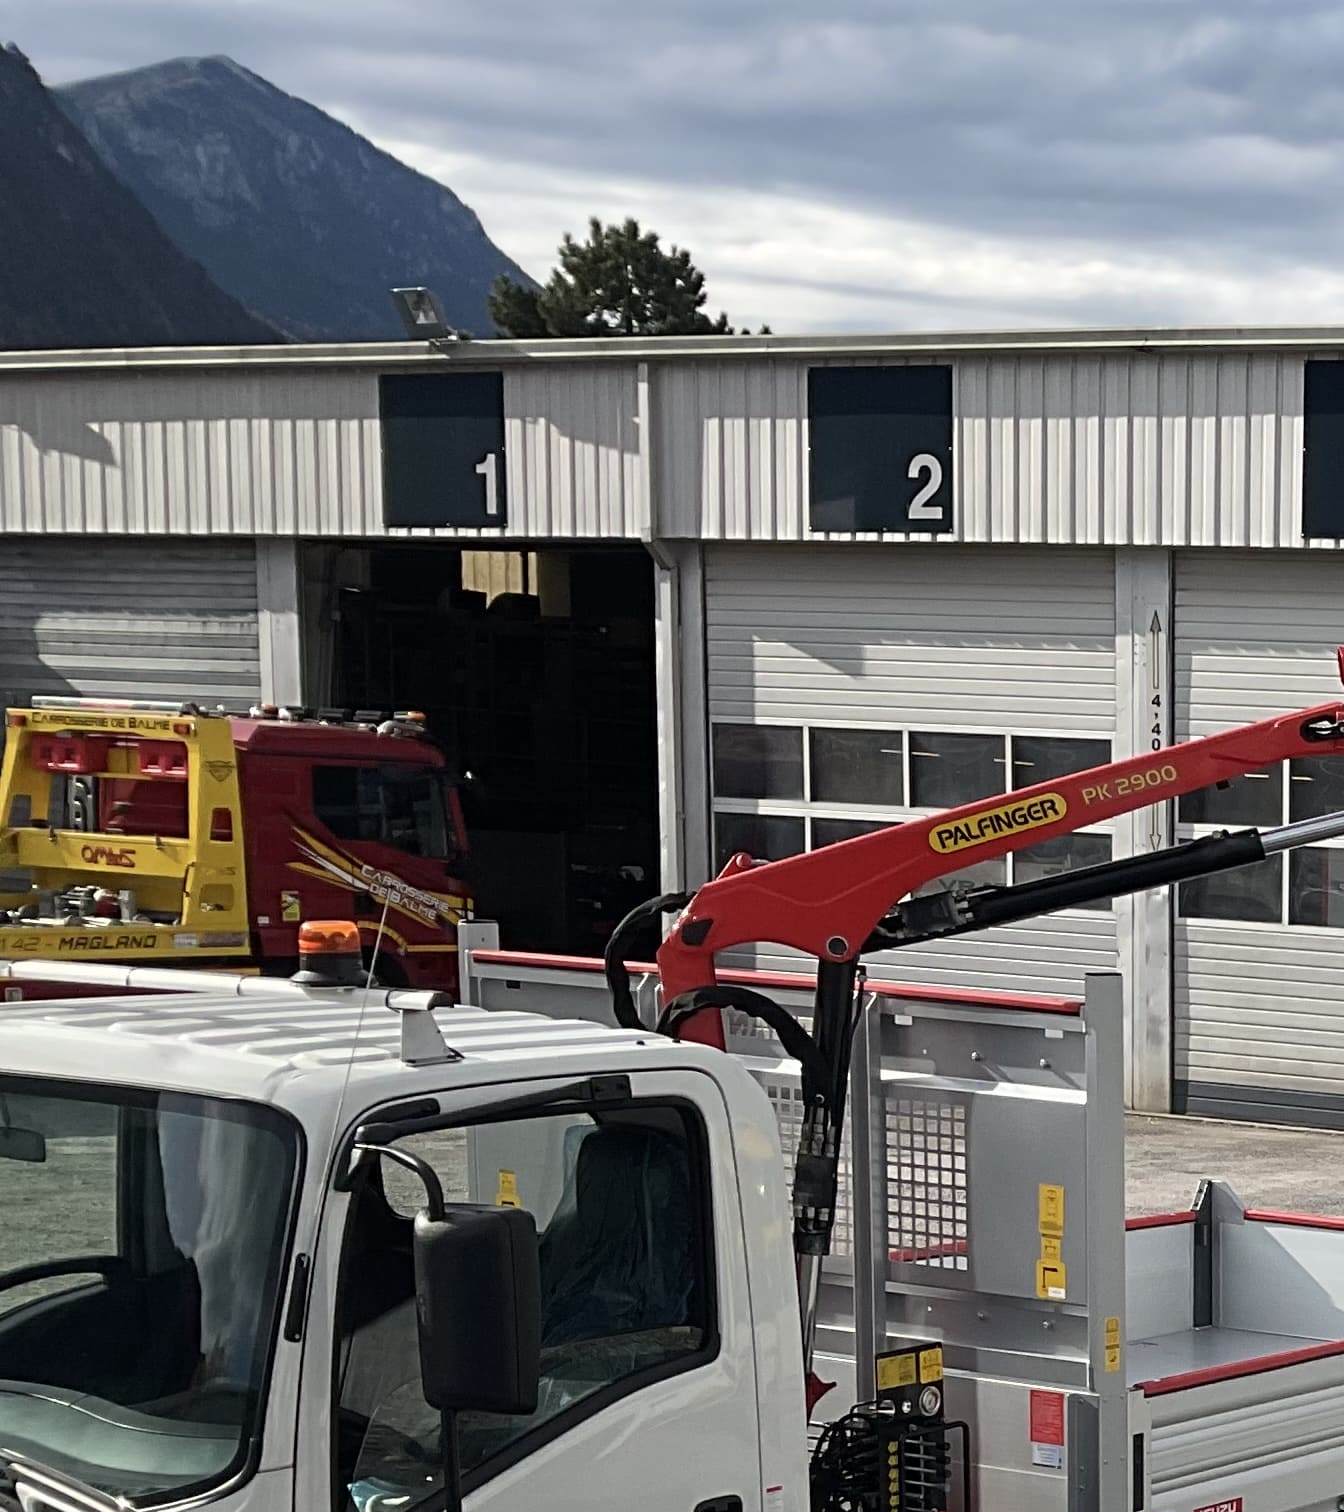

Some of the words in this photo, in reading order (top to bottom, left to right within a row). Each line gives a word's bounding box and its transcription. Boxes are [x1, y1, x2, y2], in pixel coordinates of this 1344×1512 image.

[475, 453, 497, 515] 1
[907, 453, 943, 520] 2
[1081, 785, 1113, 806] PK
[1115, 765, 1178, 795] 2900
[936, 798, 1060, 849] PALFINGER
[361, 864, 449, 912] CARROSSERIE
[390, 888, 438, 920] BALME
[58, 935, 157, 950] MAGLAND
